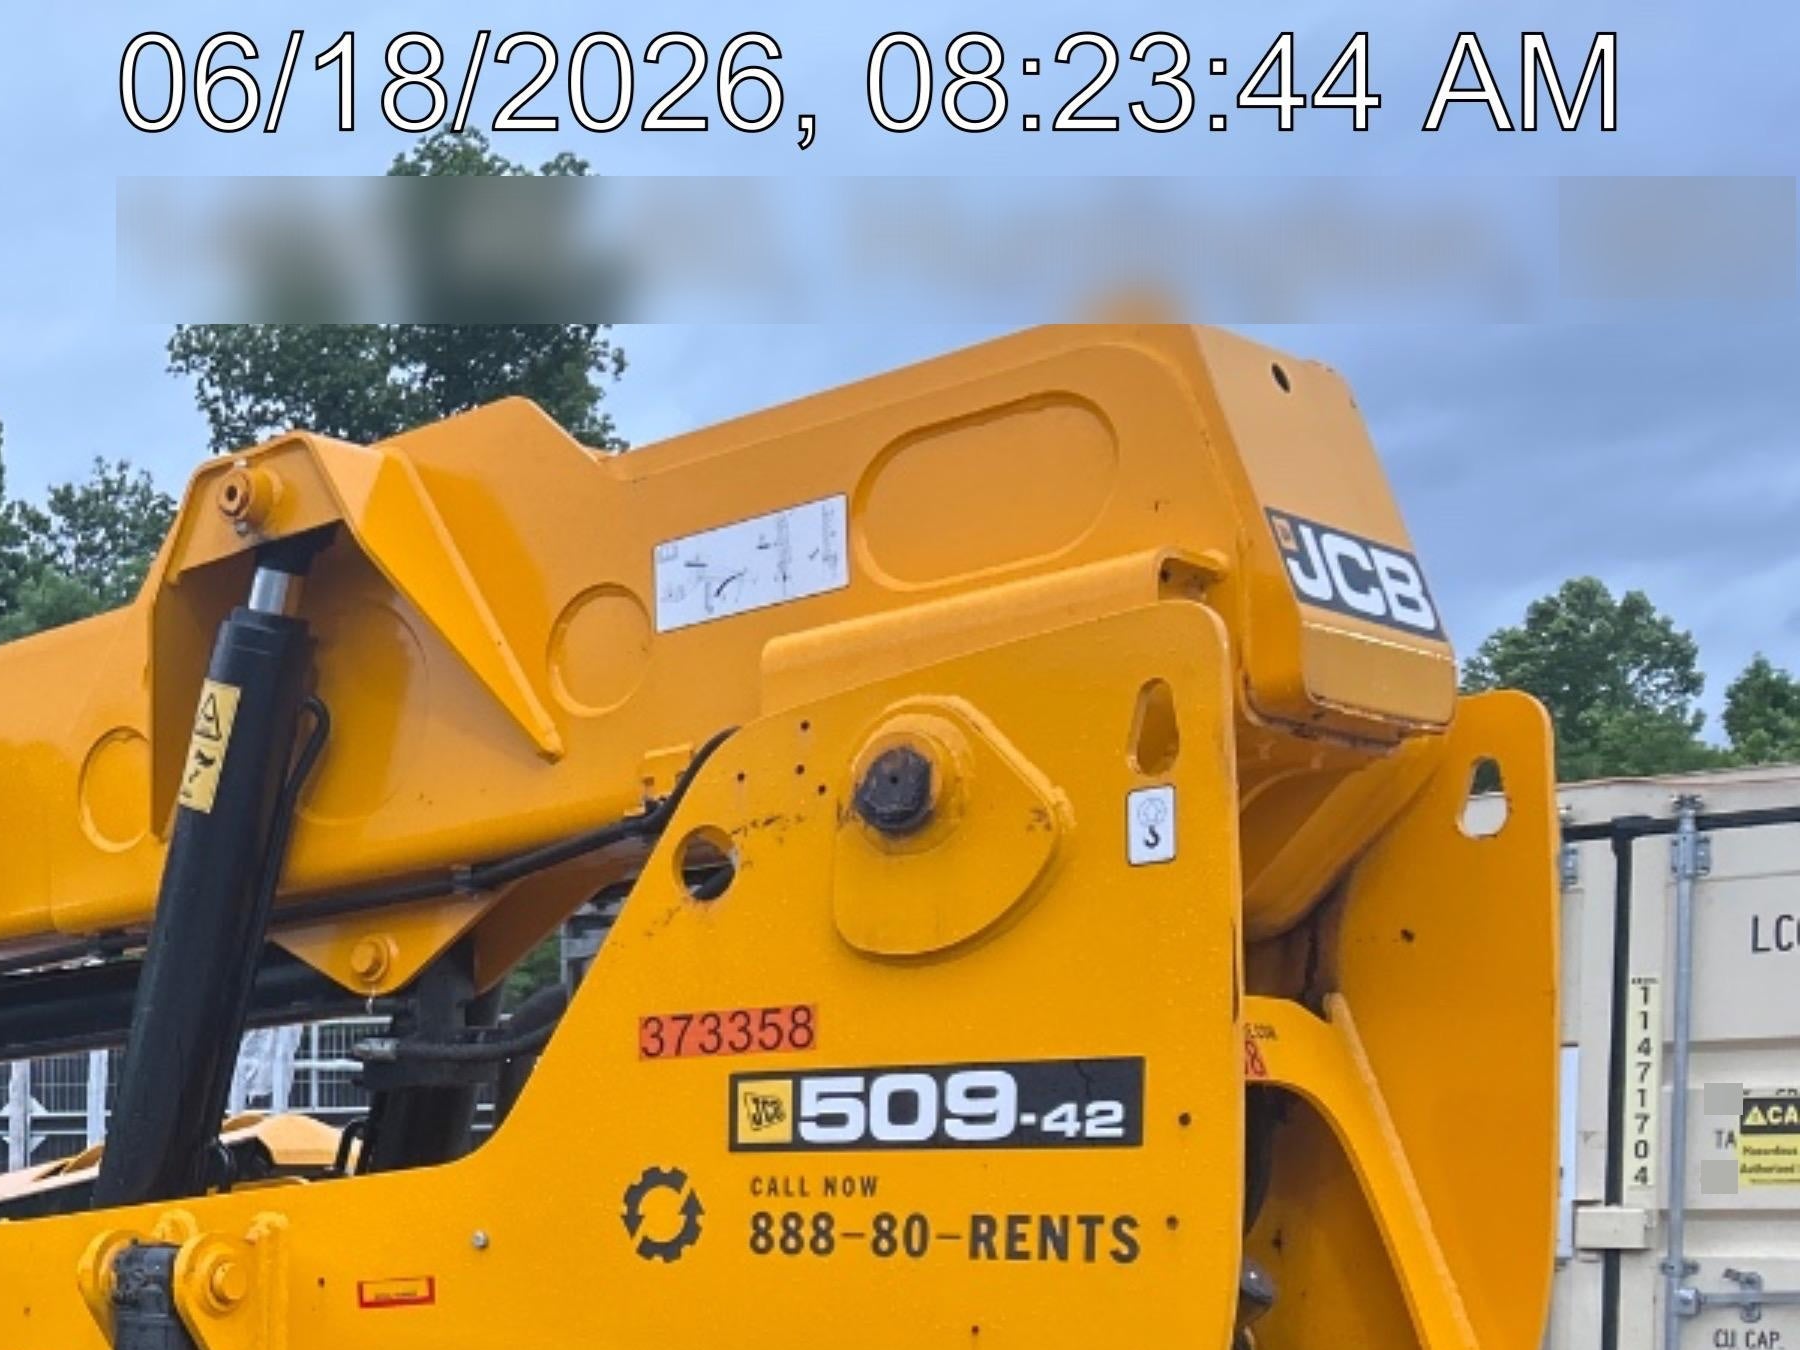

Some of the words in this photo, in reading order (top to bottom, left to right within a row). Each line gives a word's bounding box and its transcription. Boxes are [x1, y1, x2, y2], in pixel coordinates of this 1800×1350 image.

[1286, 523, 1436, 631] JCB
[640, 1004, 816, 1059] 373358
[798, 1069, 1125, 1142] 509-42
[749, 1175, 810, 1198] CALL
[823, 1174, 879, 1198] NOW
[749, 1210, 1141, 1263] 888-80-RENTS
